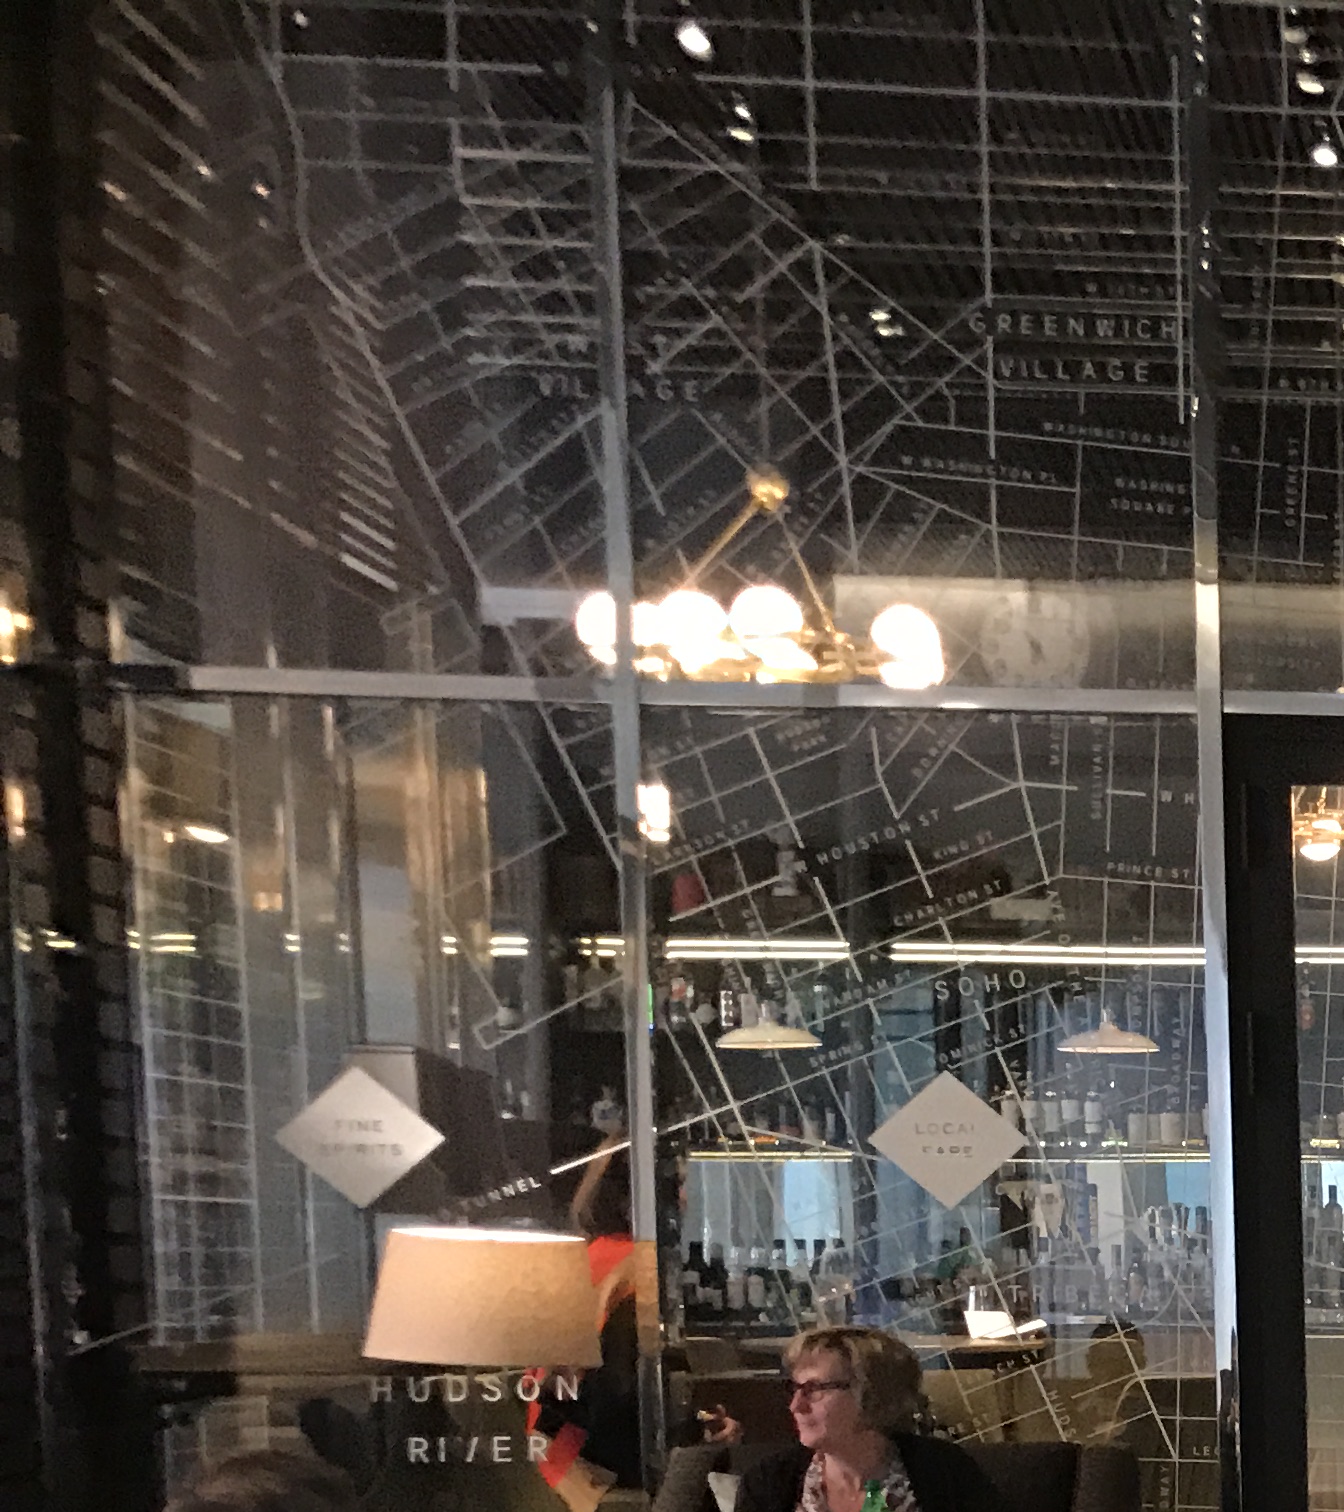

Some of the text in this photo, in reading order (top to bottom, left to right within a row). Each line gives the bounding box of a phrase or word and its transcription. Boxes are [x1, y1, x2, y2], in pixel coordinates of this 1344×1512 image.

[968, 312, 1178, 341] GREENWICH
[1000, 358, 1150, 383] VILLAGE
[538, 373, 698, 401] VILAGE
[1113, 477, 1187, 495] WASHING
[815, 808, 940, 866] HOUSTON ST
[1105, 861, 1190, 879] PRINCE ST
[933, 968, 1027, 1001] SOHO
[369, 1372, 580, 1402] HUDSON
[407, 1435, 549, 1463] RIVER
